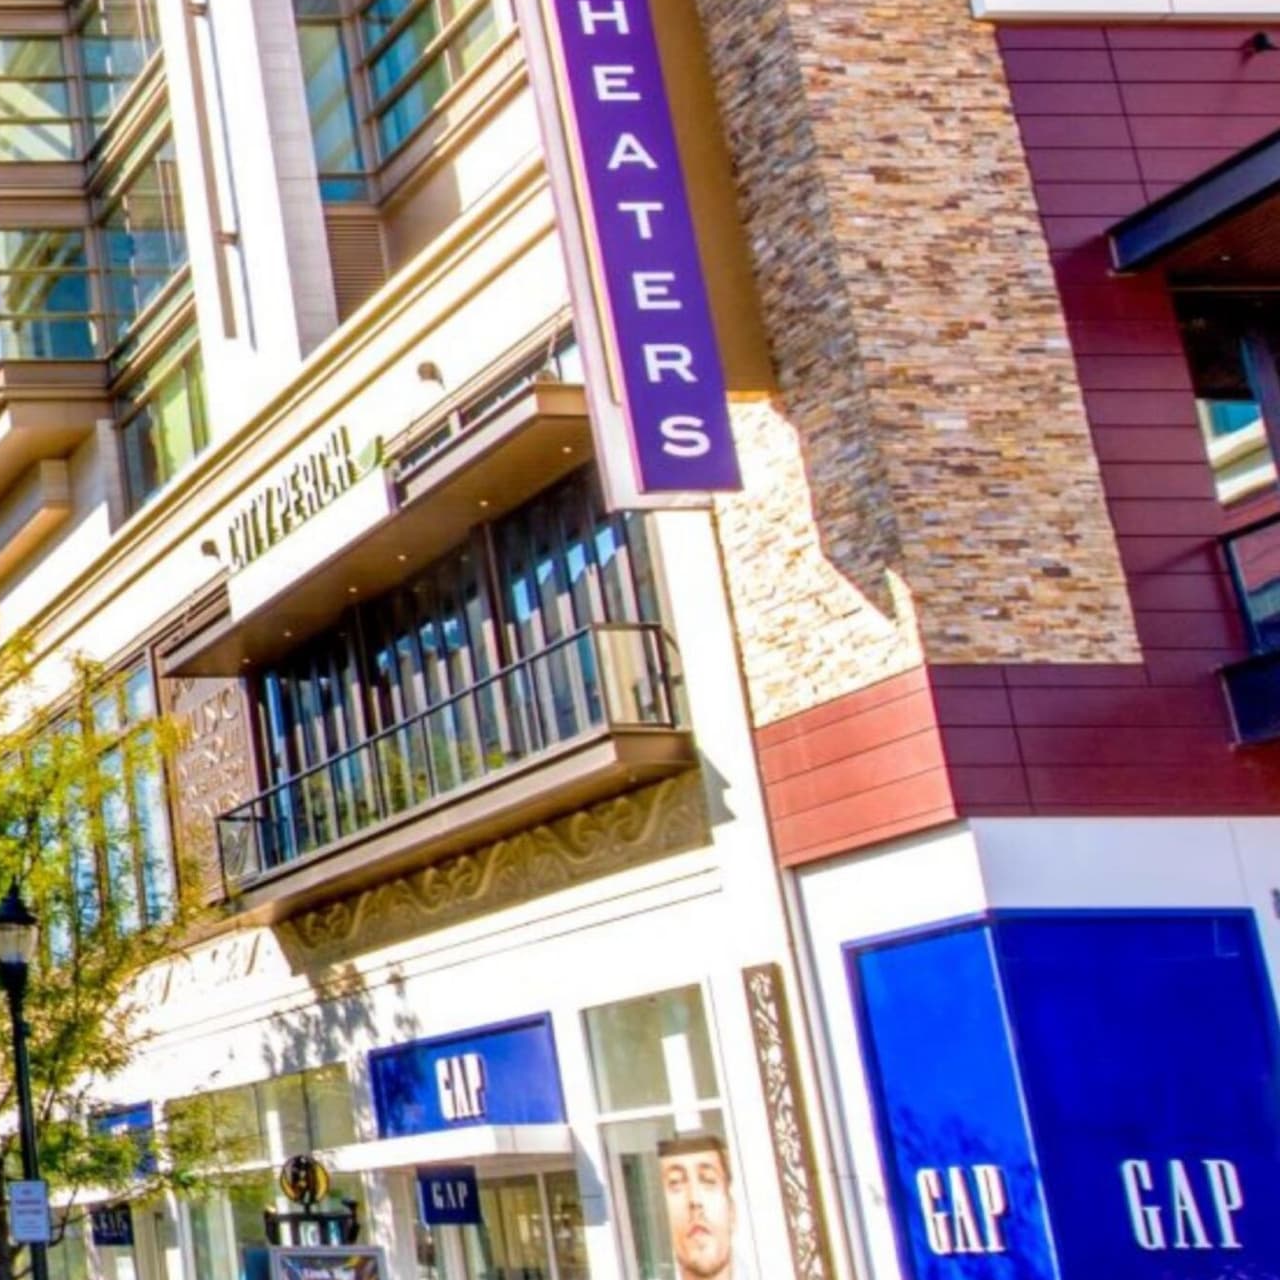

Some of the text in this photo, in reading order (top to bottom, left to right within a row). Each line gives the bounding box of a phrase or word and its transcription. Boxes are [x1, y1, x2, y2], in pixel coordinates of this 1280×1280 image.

[435, 1052, 487, 1121] GAP
[431, 1181, 468, 1210] GAP
[916, 1164, 1007, 1255] GAP
[1120, 1158, 1244, 1250] GAP
